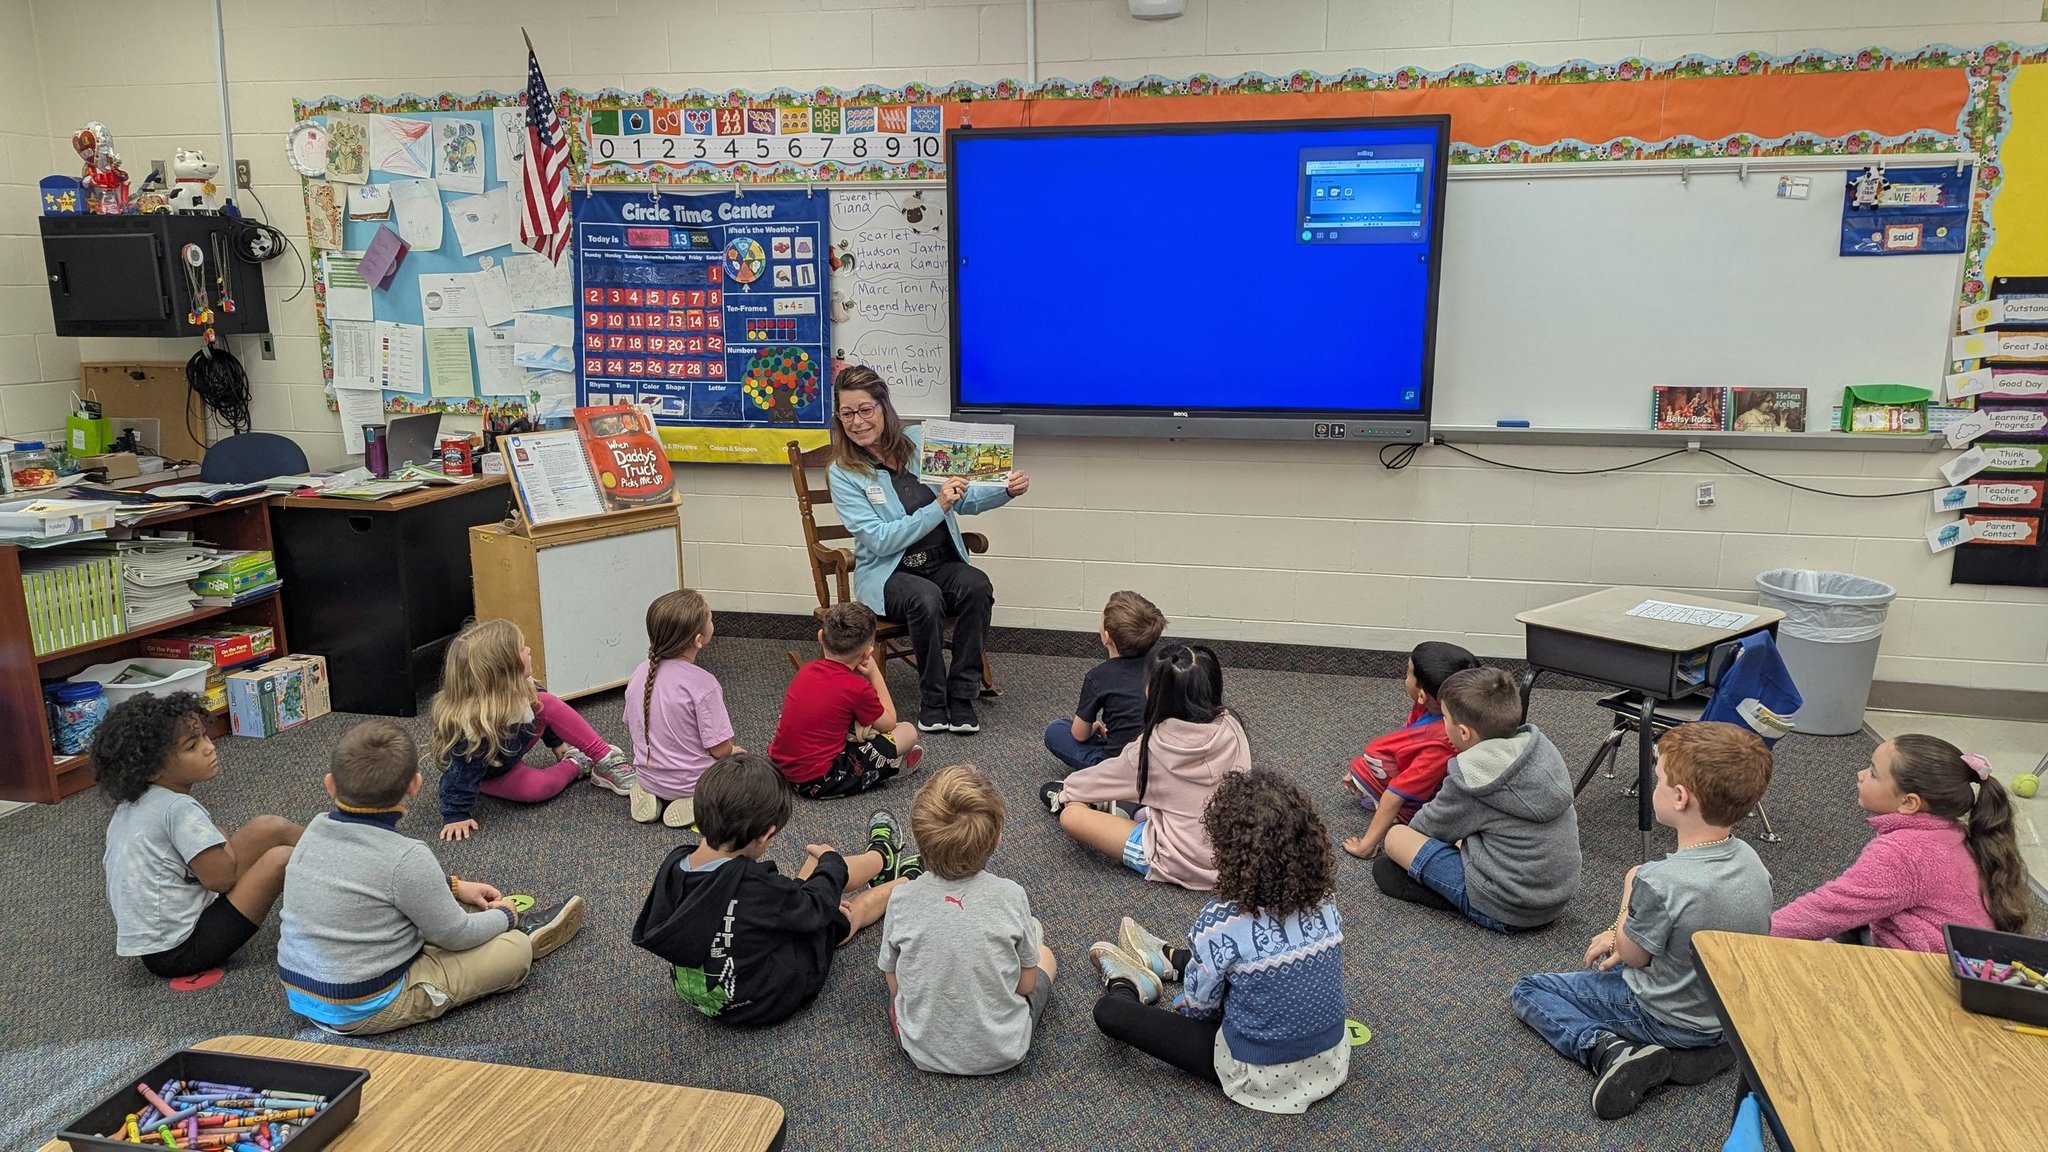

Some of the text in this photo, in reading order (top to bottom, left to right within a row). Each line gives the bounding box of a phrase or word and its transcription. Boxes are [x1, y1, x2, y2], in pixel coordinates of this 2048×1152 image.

[600, 136, 939, 159] 0 1 2 3 4 5 6 7 8 9 10
[840, 191, 881, 201] Everett
[621, 202, 775, 223] Circle Time Center
[834, 202, 871, 214] Tiana
[728, 226, 751, 234] What's
[587, 234, 609, 244] Today
[611, 235, 619, 243] is
[674, 233, 688, 245] 13
[691, 235, 709, 243] 2025
[859, 229, 910, 243] Scarlet
[1892, 232, 1914, 241] said
[857, 247, 900, 258] Hudson
[859, 260, 901, 271] Adhara
[711, 268, 717, 280] 1
[858, 283, 890, 295] Marc
[896, 281, 923, 294] Toni
[590, 290, 718, 304] 2 3 4 5 6 7 8
[860, 298, 938, 322] Legend Avery
[590, 314, 720, 328] 9 10 11 12 13 14 15
[588, 336, 721, 351] 16 17 18 19 20 21 22
[2002, 342, 2030, 351] Great
[727, 347, 757, 355] Numbers
[860, 343, 943, 358] Calvin Saint
[587, 360, 722, 375] 23 24 25 26 27 28 30
[902, 361, 942, 380] Gabby
[886, 375, 924, 387] Callie
[1998, 379, 2043, 390] Good Day
[1776, 392, 1801, 400] Helen
[1666, 415, 1712, 424] Betsy Ross
[1989, 413, 2043, 423] Learning In
[1994, 420, 2035, 430] Progress
[606, 439, 629, 450] When
[613, 447, 657, 466] Daddy's
[2000, 450, 2024, 458] Think
[1990, 458, 2030, 466] About It
[621, 462, 657, 478] Truck
[621, 477, 639, 488] Picks
[1983, 486, 2029, 495] Teacher's
[1989, 494, 2019, 502] Choice
[1986, 522, 2016, 530] Parent
[1982, 530, 2017, 538] Contact
[166, 646, 181, 654] Farm
